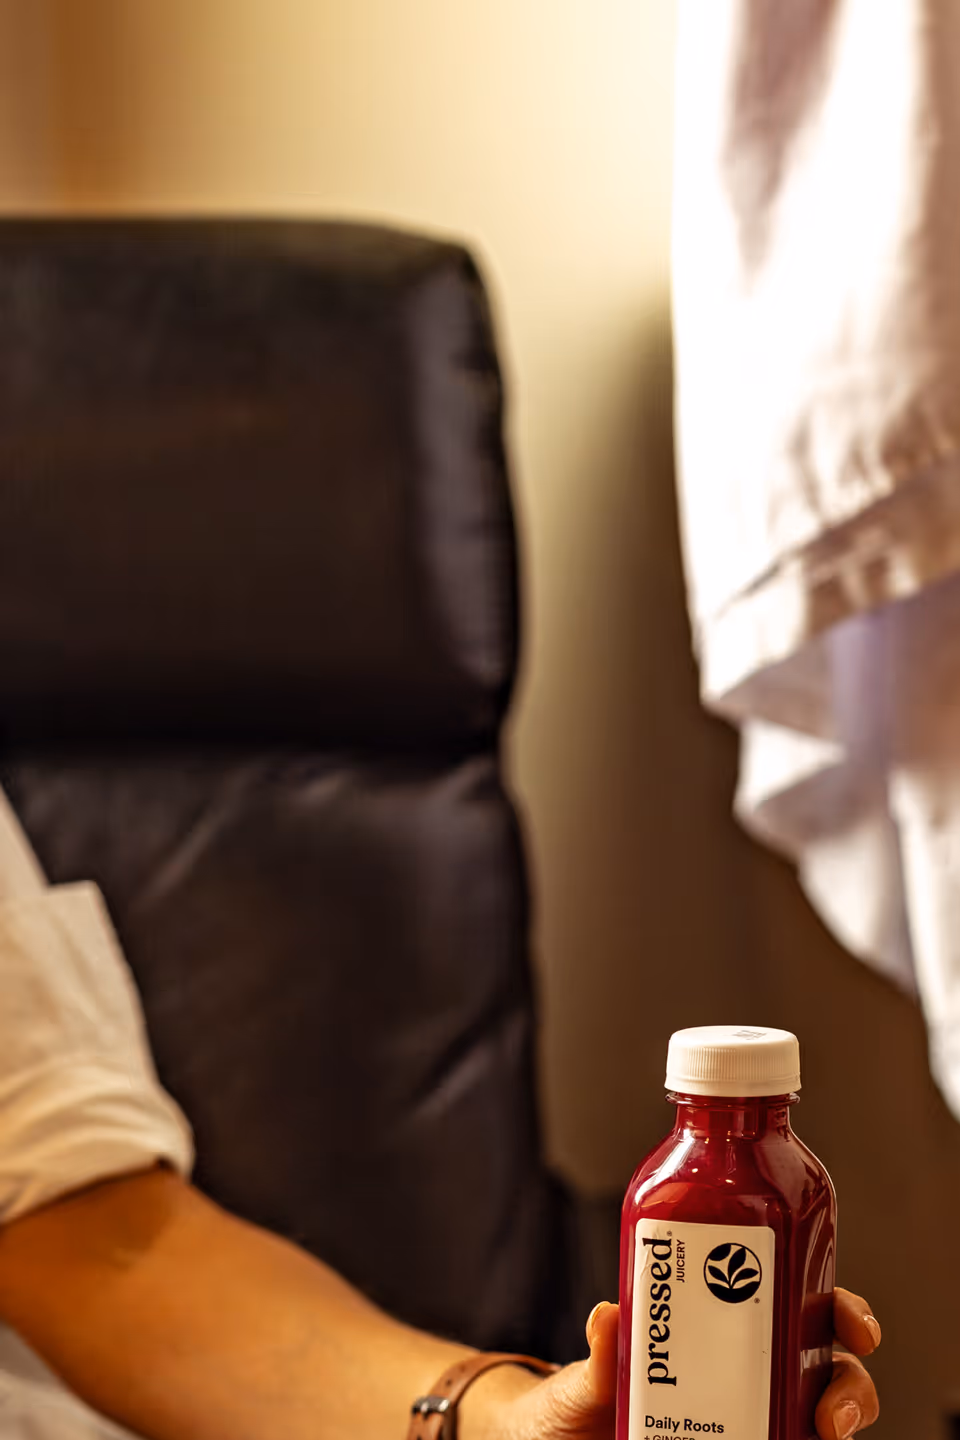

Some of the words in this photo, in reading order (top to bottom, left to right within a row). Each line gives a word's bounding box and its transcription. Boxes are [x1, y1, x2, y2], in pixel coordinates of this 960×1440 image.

[676, 1239, 685, 1283] JUICERY
[642, 1237, 677, 1386] pressed
[645, 1415, 680, 1433] Daily
[683, 1418, 725, 1433] Roots
